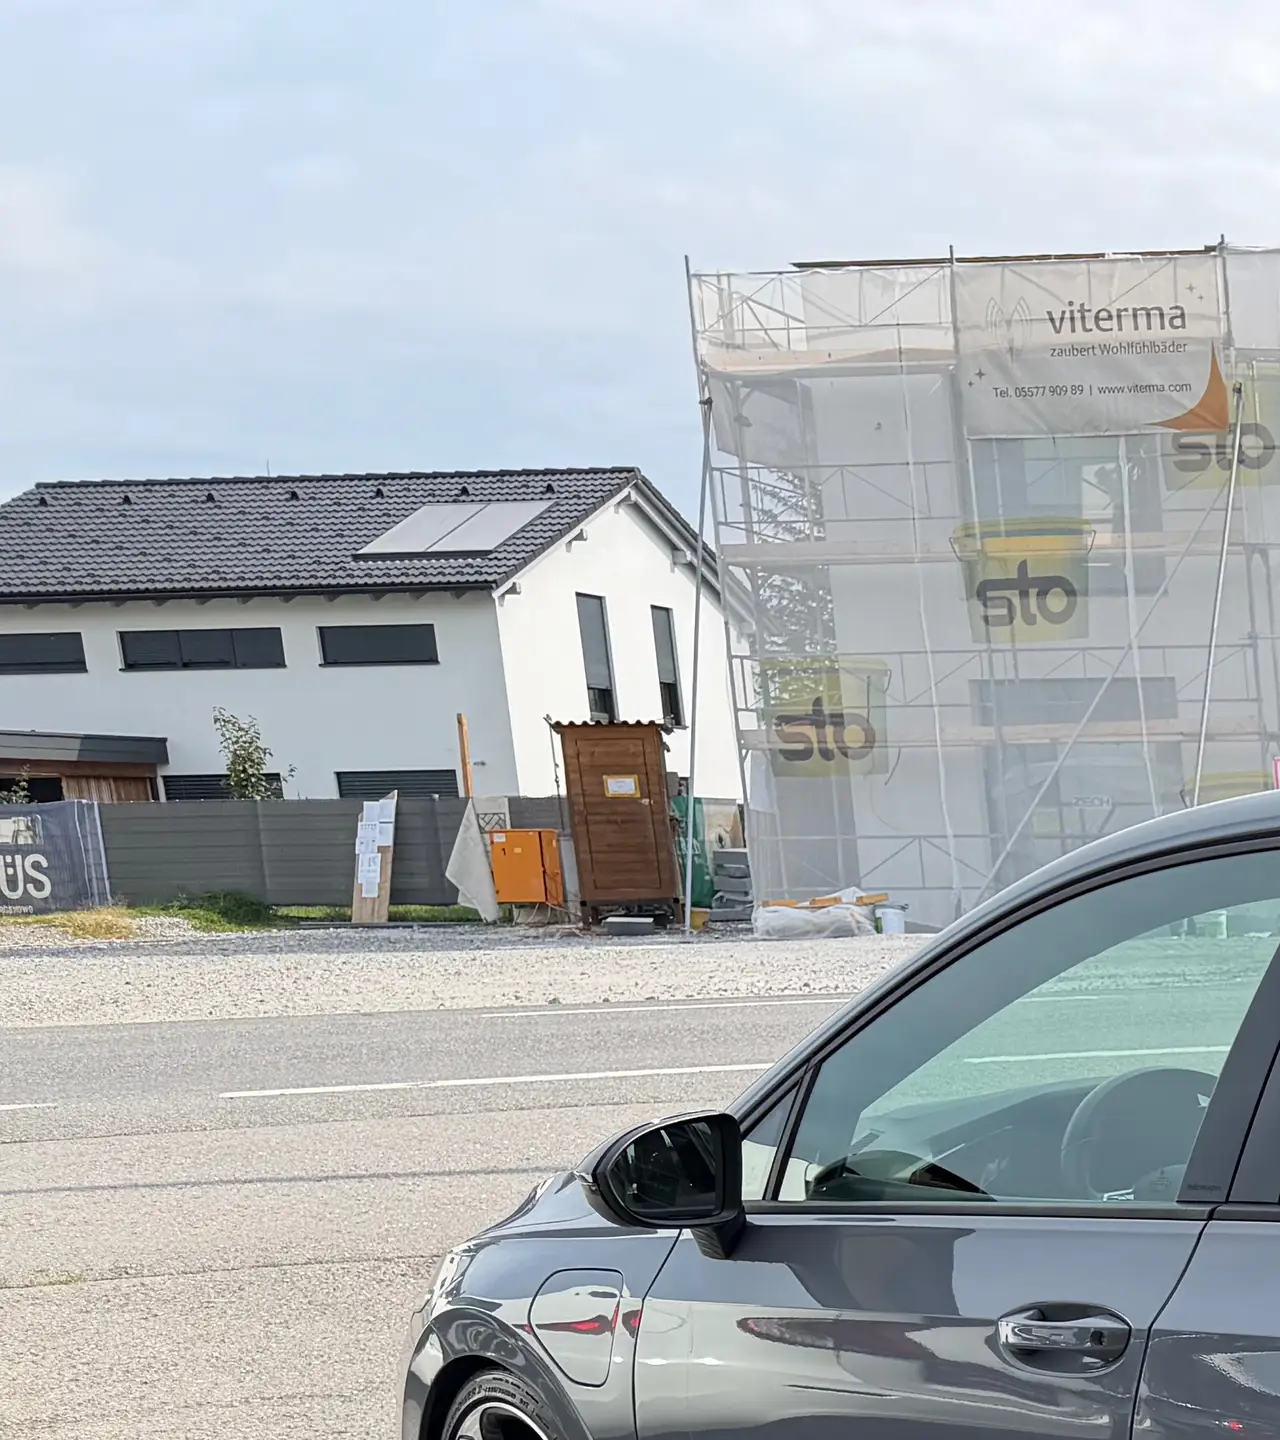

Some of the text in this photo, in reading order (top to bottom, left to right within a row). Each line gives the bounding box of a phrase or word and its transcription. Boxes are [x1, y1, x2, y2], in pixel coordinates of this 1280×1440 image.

[1046, 301, 1187, 334] viterma
[1050, 340, 1188, 357] zaubert Wohlfühlbäder
[993, 387, 1012, 398] Tel.
[1014, 386, 1046, 397] 05577
[1048, 385, 1069, 397] 909
[1070, 384, 1084, 396] 89
[1097, 382, 1192, 395] www.viterma.com
[976, 559, 1077, 627] sto
[775, 696, 875, 761] sto
